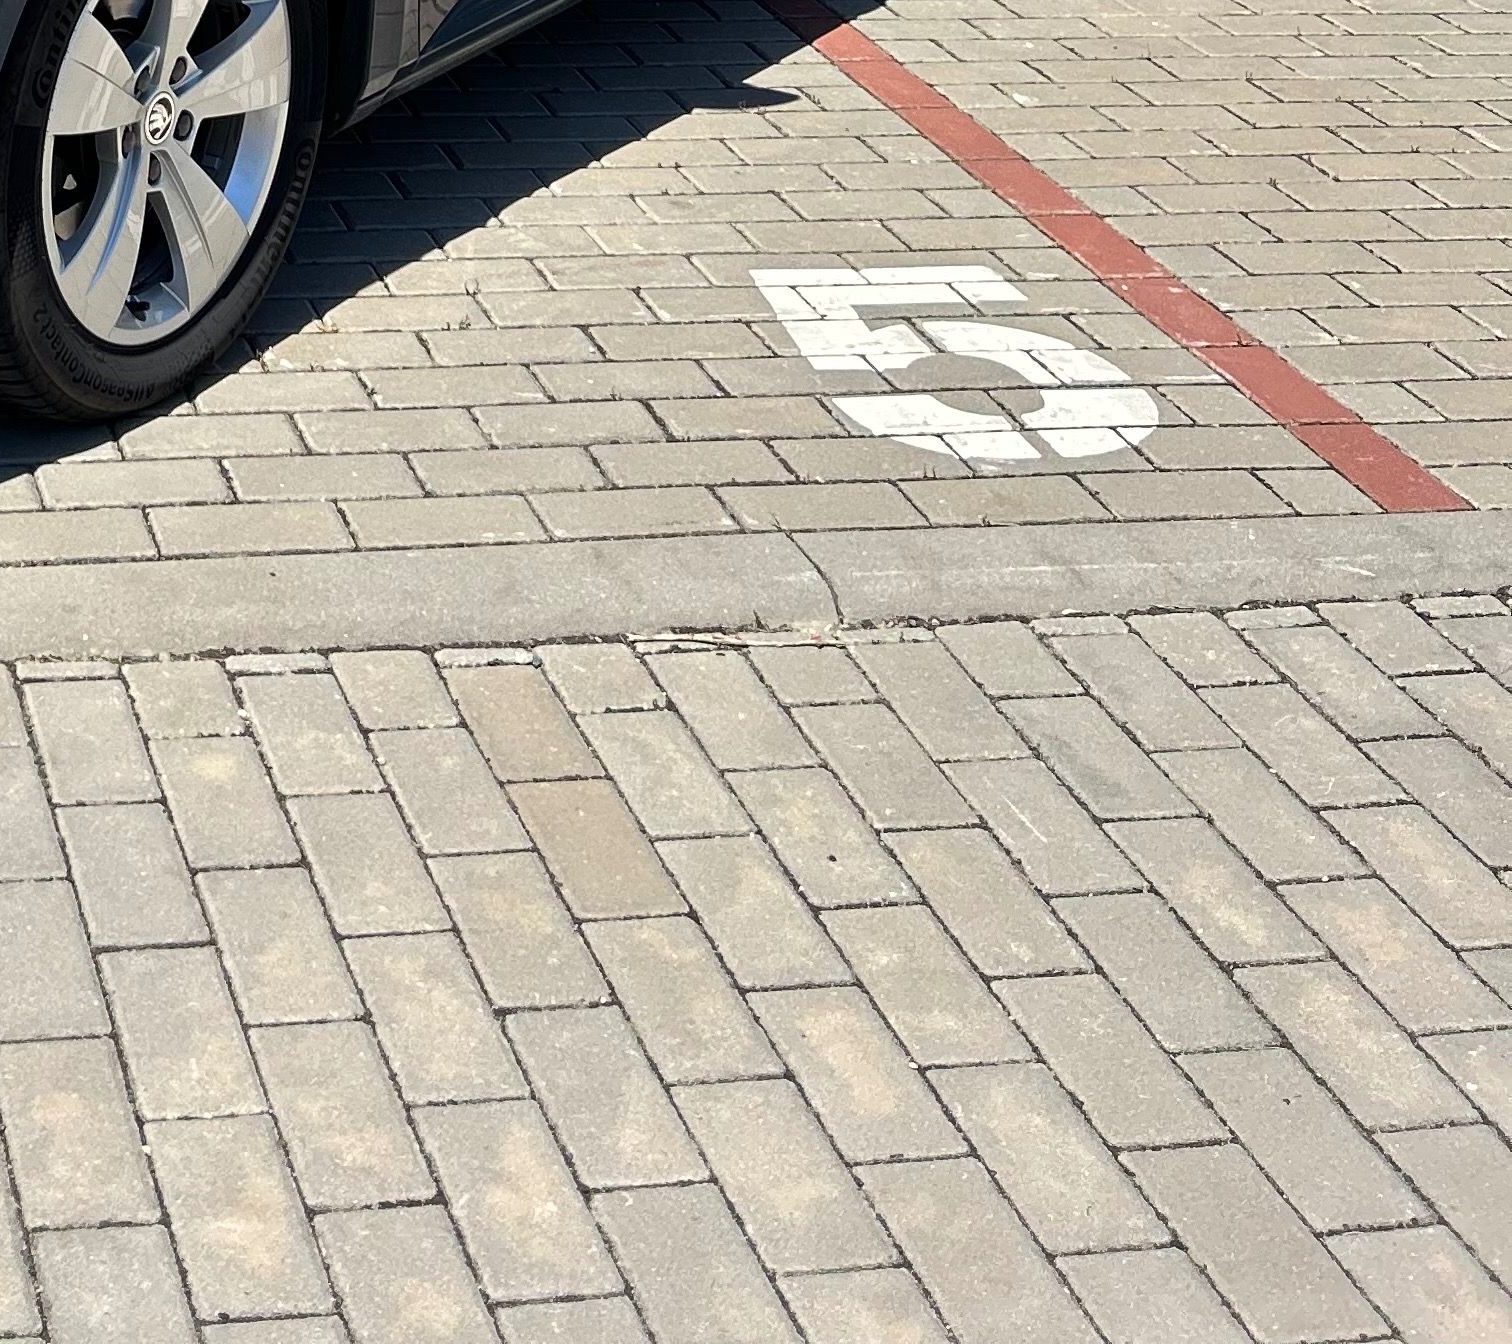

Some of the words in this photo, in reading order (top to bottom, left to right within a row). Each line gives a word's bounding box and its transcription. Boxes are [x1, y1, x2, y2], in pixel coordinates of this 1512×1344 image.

[33, 303, 47, 321] 2
[39, 318, 156, 403] AllSeasonContact
[749, 265, 1159, 459] 5
